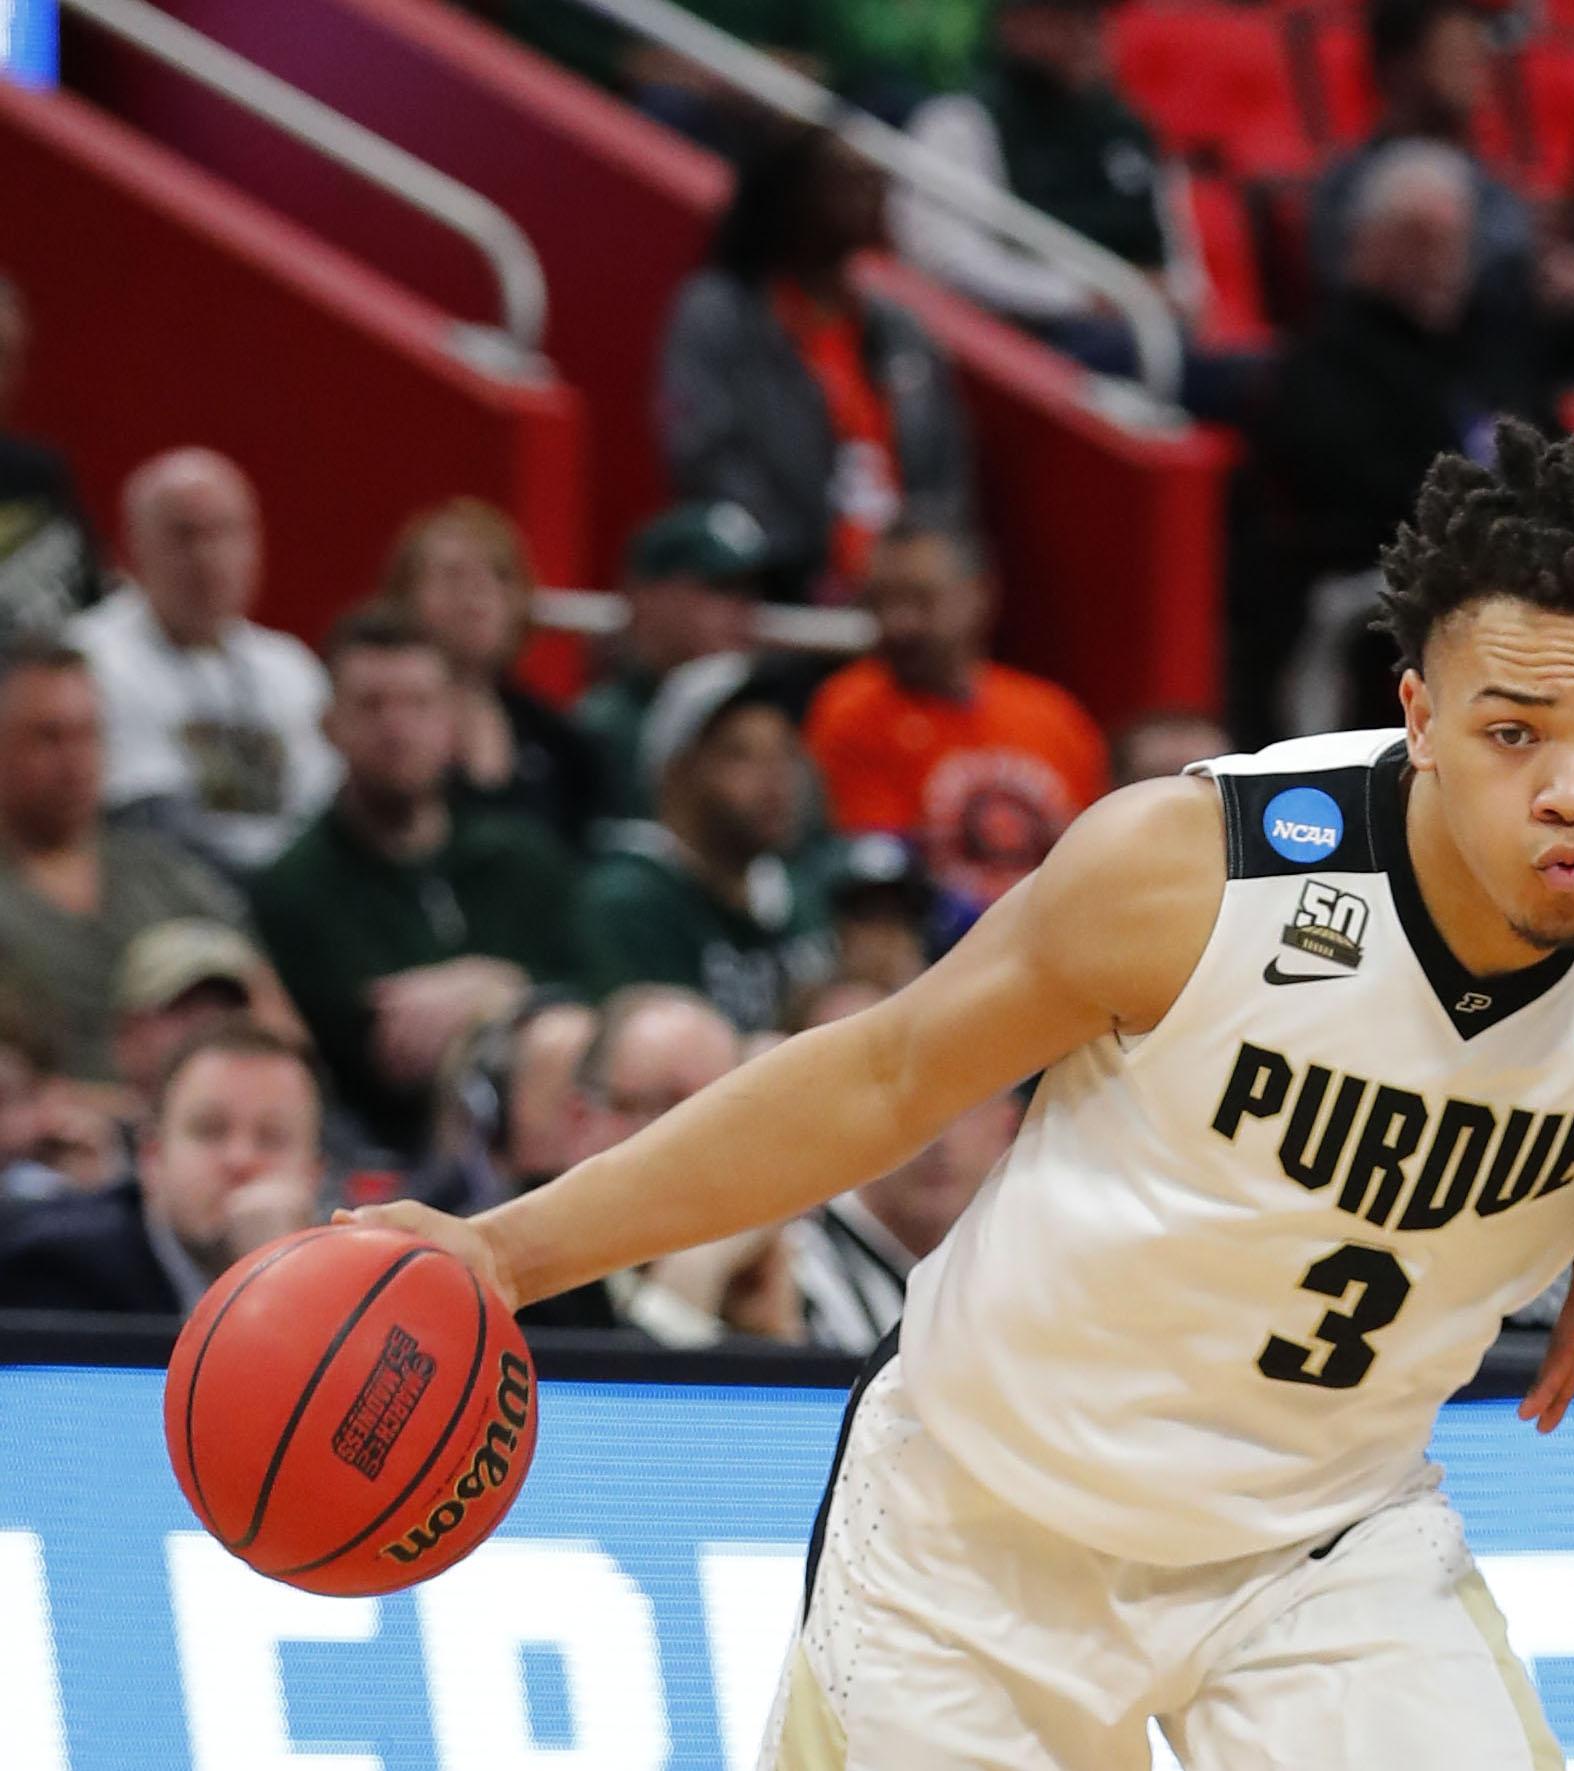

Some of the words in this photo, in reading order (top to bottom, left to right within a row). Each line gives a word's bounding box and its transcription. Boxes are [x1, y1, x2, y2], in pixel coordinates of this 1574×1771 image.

[1272, 819, 1336, 848] NCAA
[1293, 879, 1369, 948] 50
[1254, 1238, 1412, 1390] 3
[380, 1350, 530, 1564] Wilson
